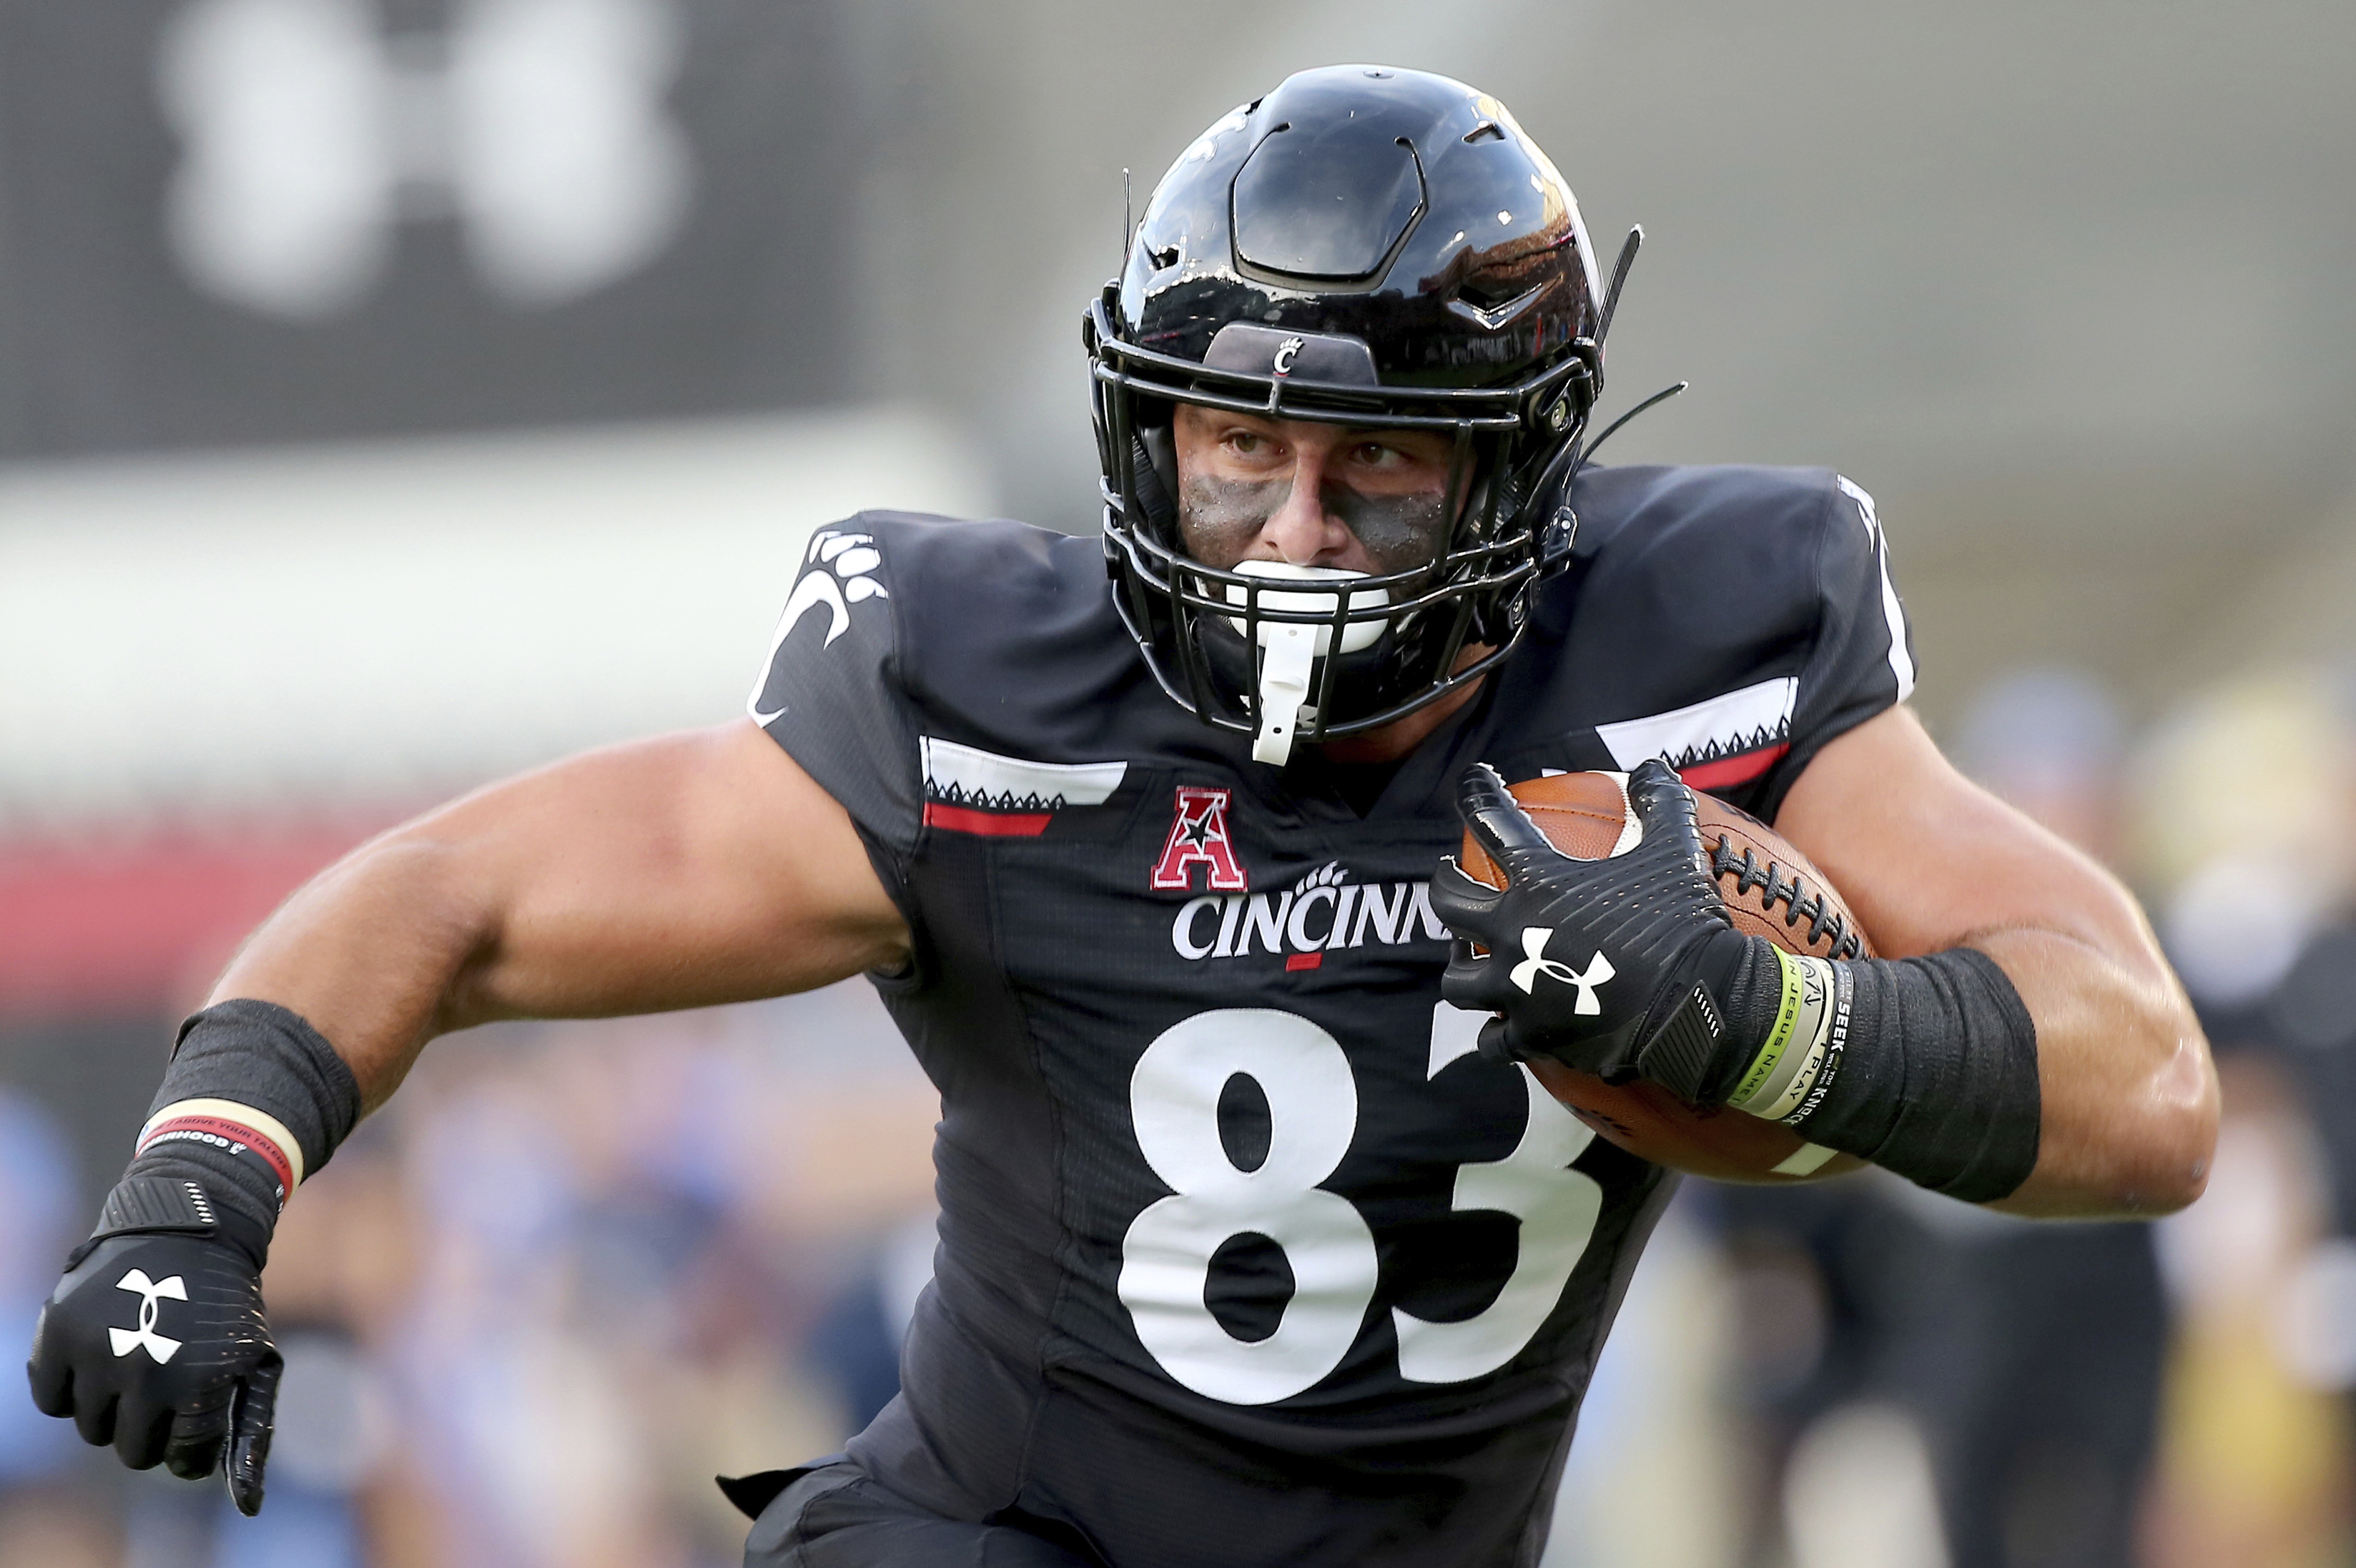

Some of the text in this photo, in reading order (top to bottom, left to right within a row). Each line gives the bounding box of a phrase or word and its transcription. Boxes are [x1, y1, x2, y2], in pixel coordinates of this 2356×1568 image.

[1150, 785, 1248, 891] A
[1172, 881, 1453, 961] CINCINN
[1787, 959, 1798, 976] IN
[1773, 982, 1798, 1047] JESUS
[1830, 1001, 1851, 1052] SEEK
[1740, 1054, 1776, 1096] NAME
[1790, 1056, 1821, 1100] PLAY
[1825, 1070, 1836, 1086] YOU
[220, 1122, 252, 1138] YOUR
[254, 1138, 286, 1170] TALENT
[1117, 999, 1603, 1406] 83
